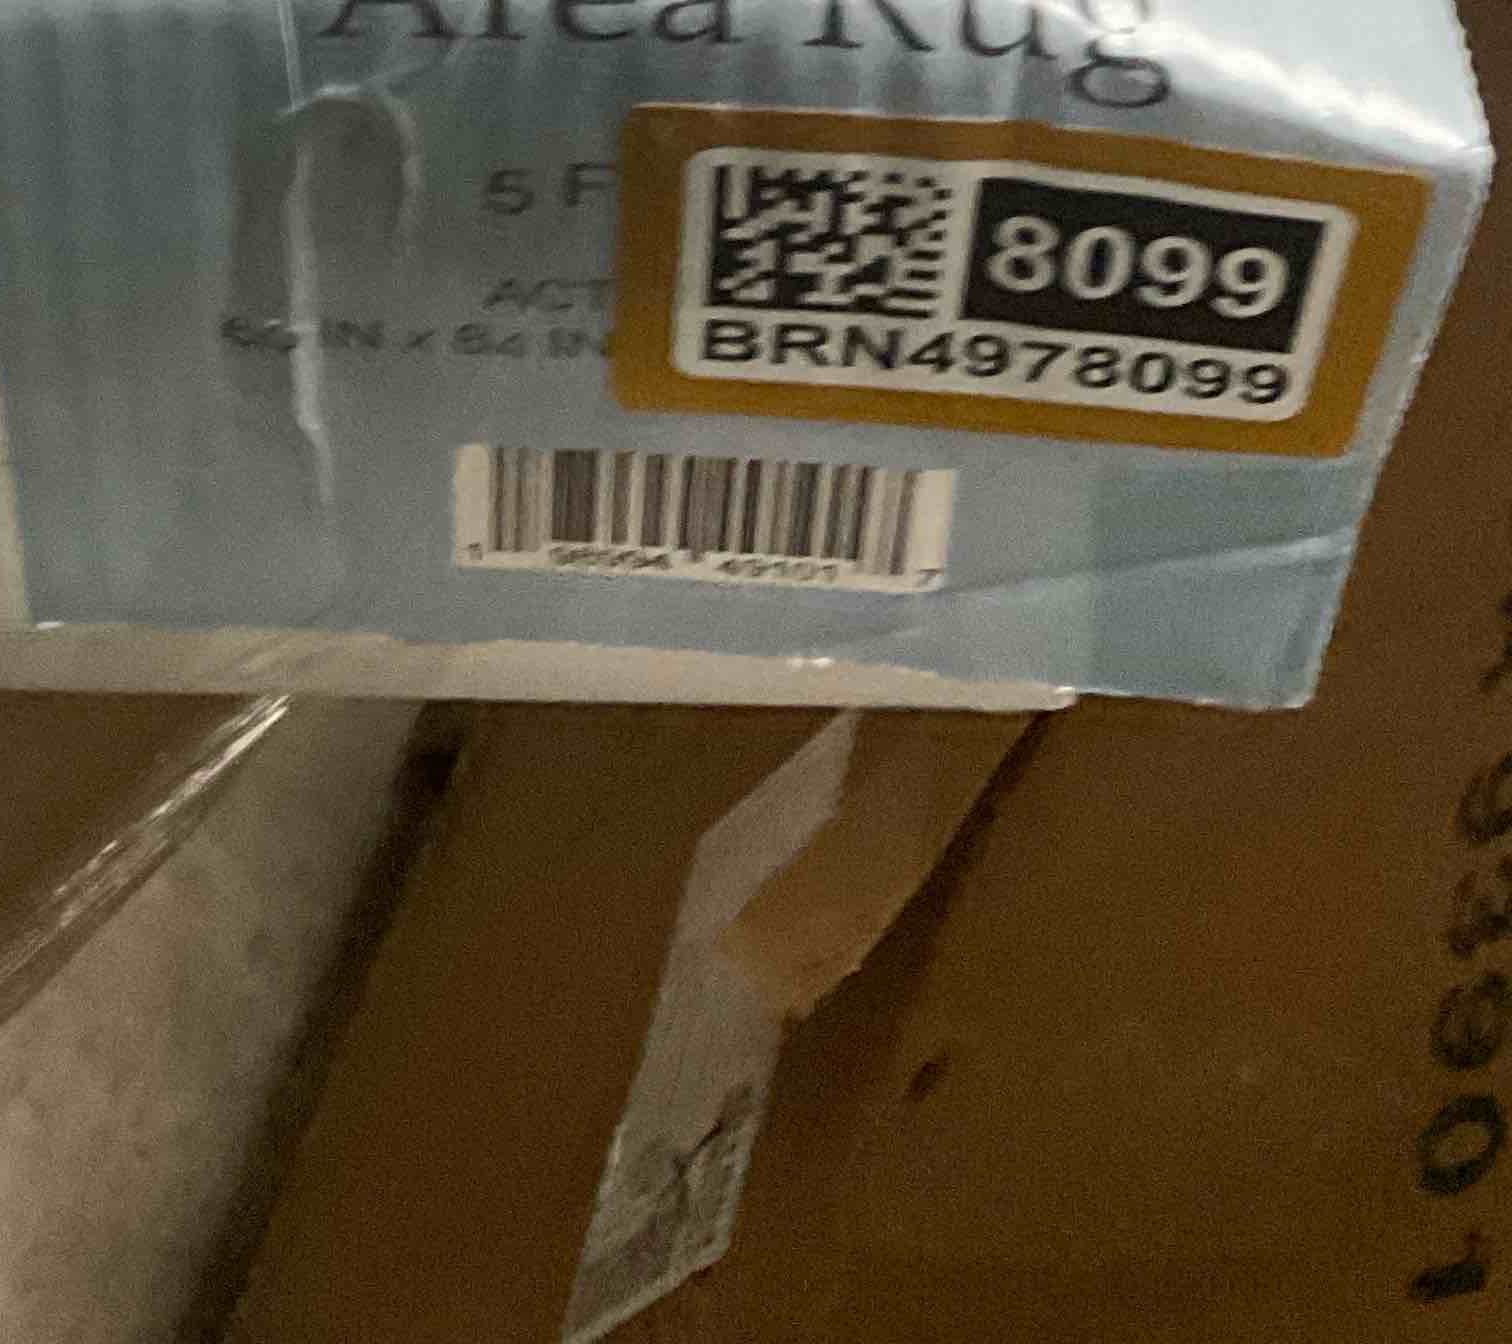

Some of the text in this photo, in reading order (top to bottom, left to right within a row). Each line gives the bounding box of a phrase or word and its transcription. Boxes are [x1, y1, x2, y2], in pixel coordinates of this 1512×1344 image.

[486, 167, 536, 216] 5
[987, 213, 1290, 320] 8099
[701, 318, 1291, 406] BRN4978099
